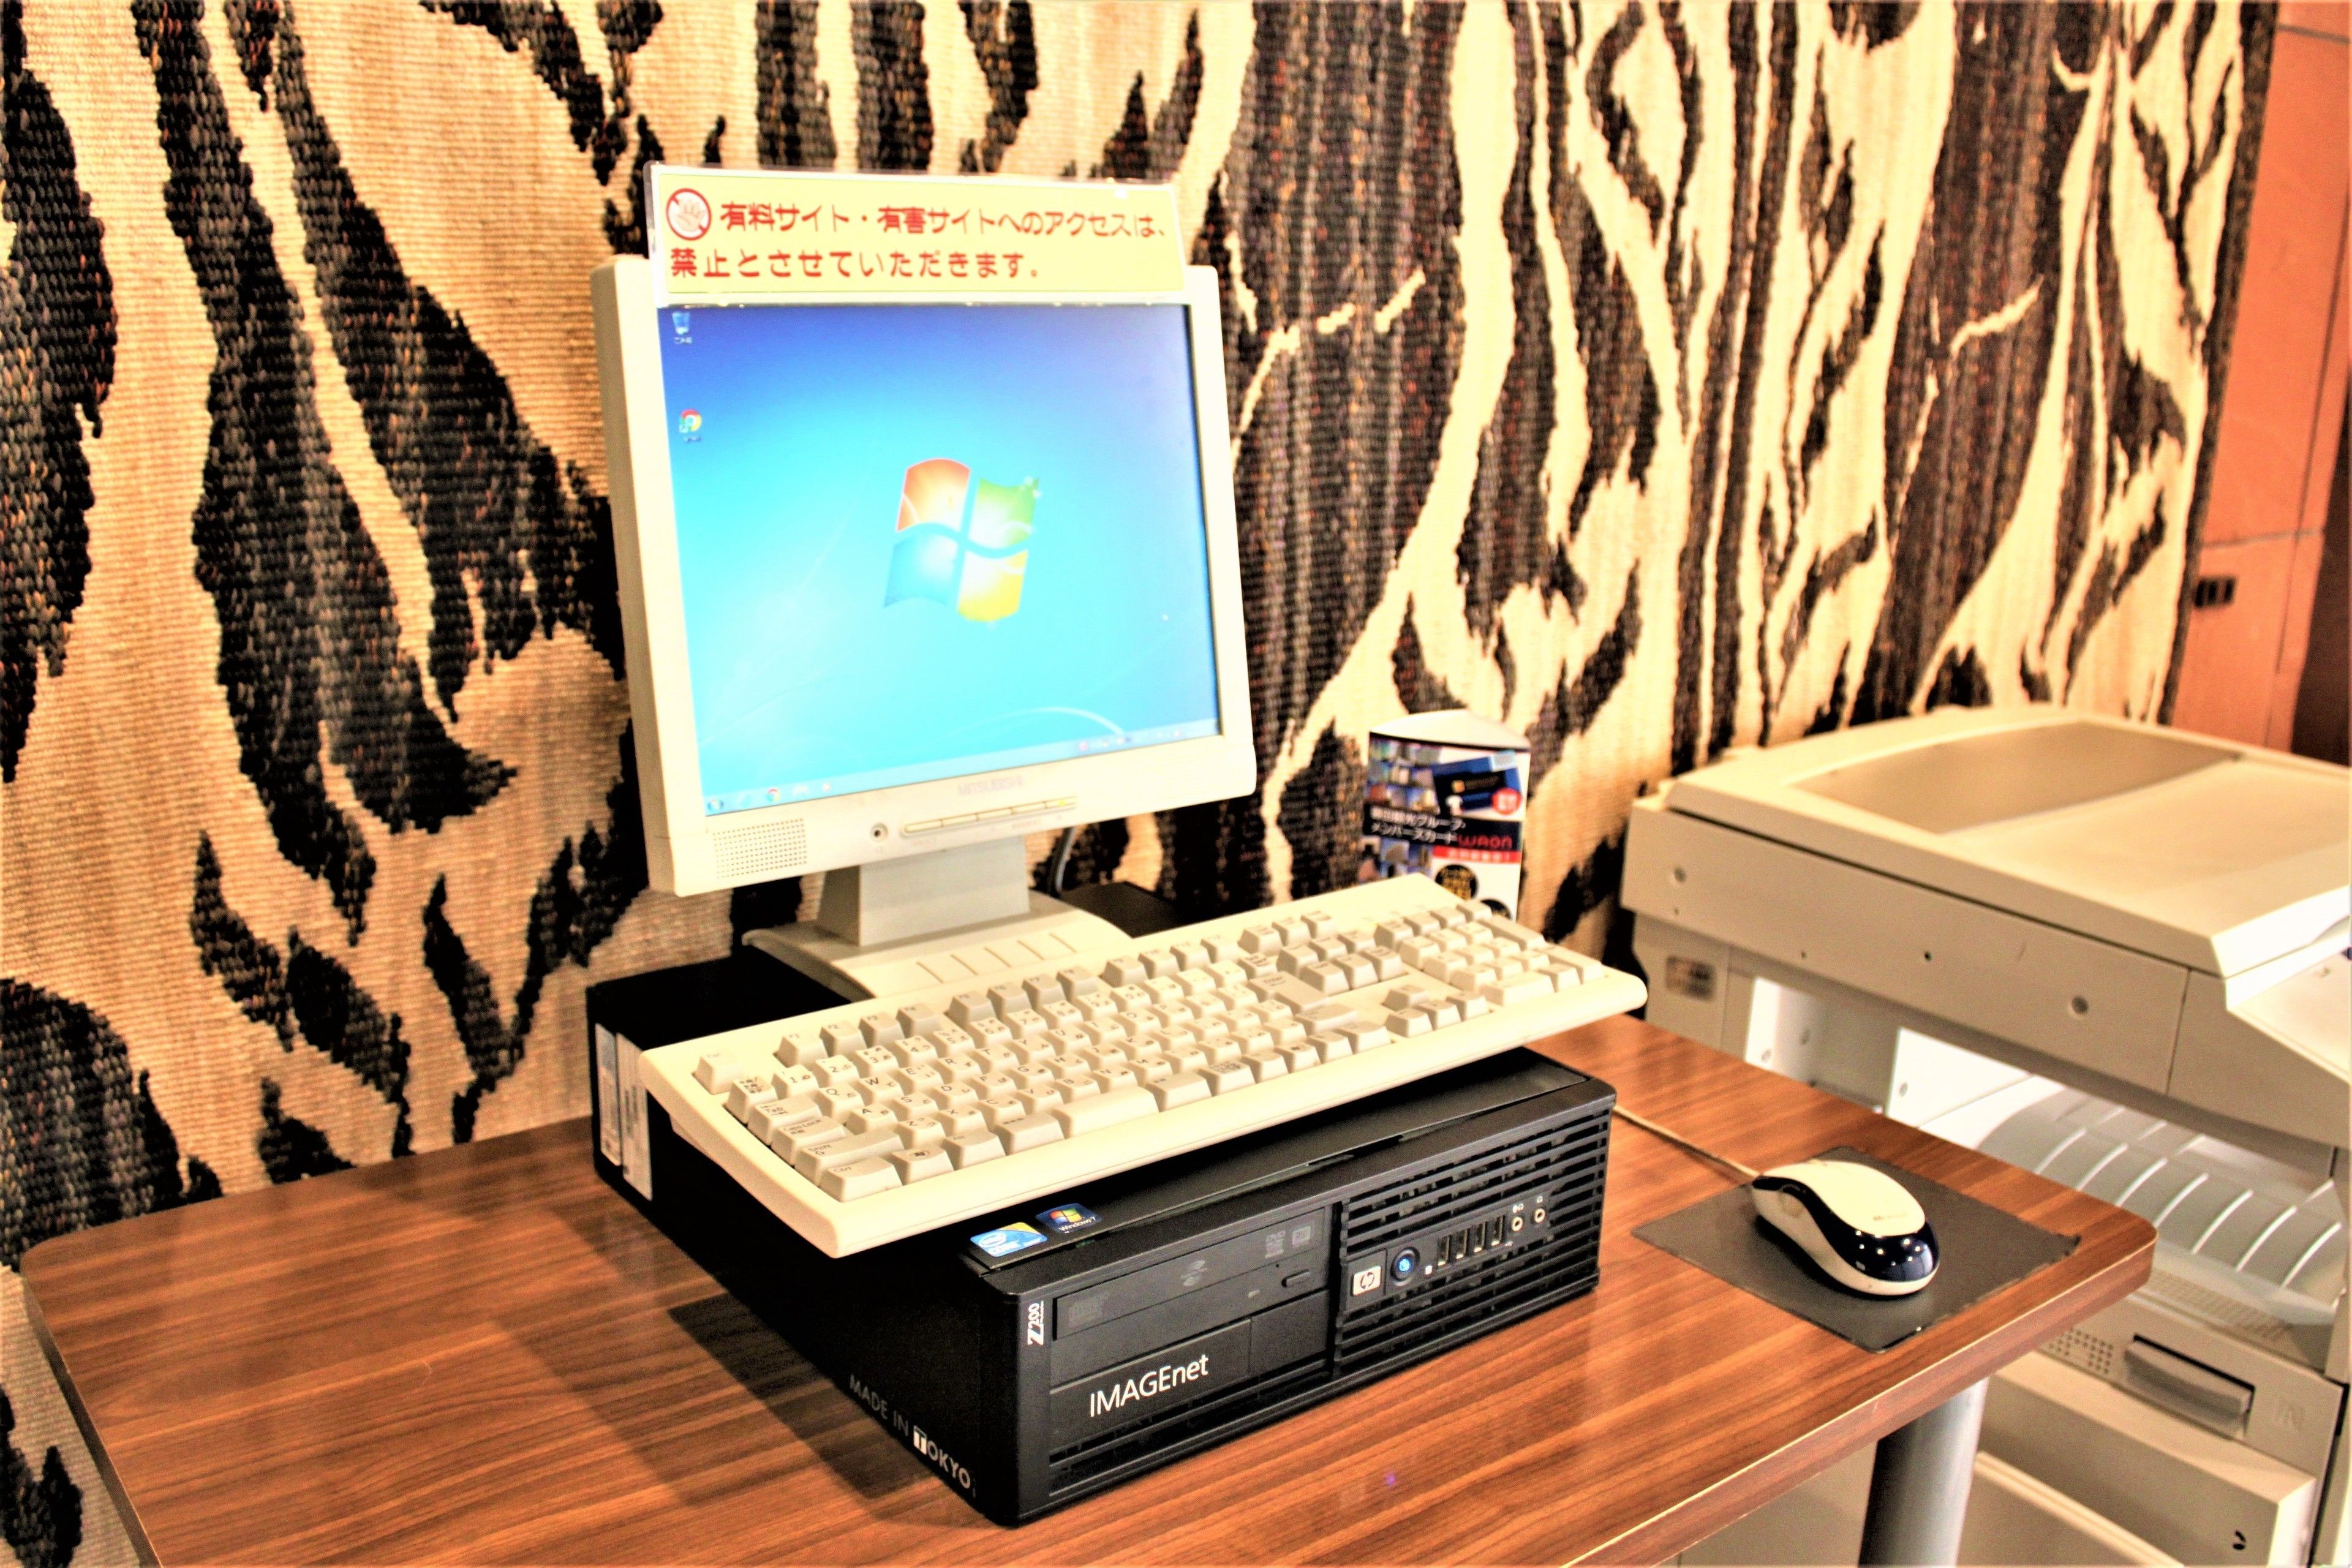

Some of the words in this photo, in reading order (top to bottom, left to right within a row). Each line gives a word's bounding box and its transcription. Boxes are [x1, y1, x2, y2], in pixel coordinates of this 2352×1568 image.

[720, 201, 1165, 238] 有料サイト・有害サイトへのアクセスは、
[670, 247, 1038, 279] 禁止とさせていただきます。
[802, 1119, 821, 1128] Lock
[1027, 1302, 1044, 1346] Z200
[1090, 1354, 1209, 1417] IMAGEnet
[850, 1374, 888, 1420] MADE
[894, 1410, 908, 1436] IN
[914, 1425, 971, 1490] TOKYO
